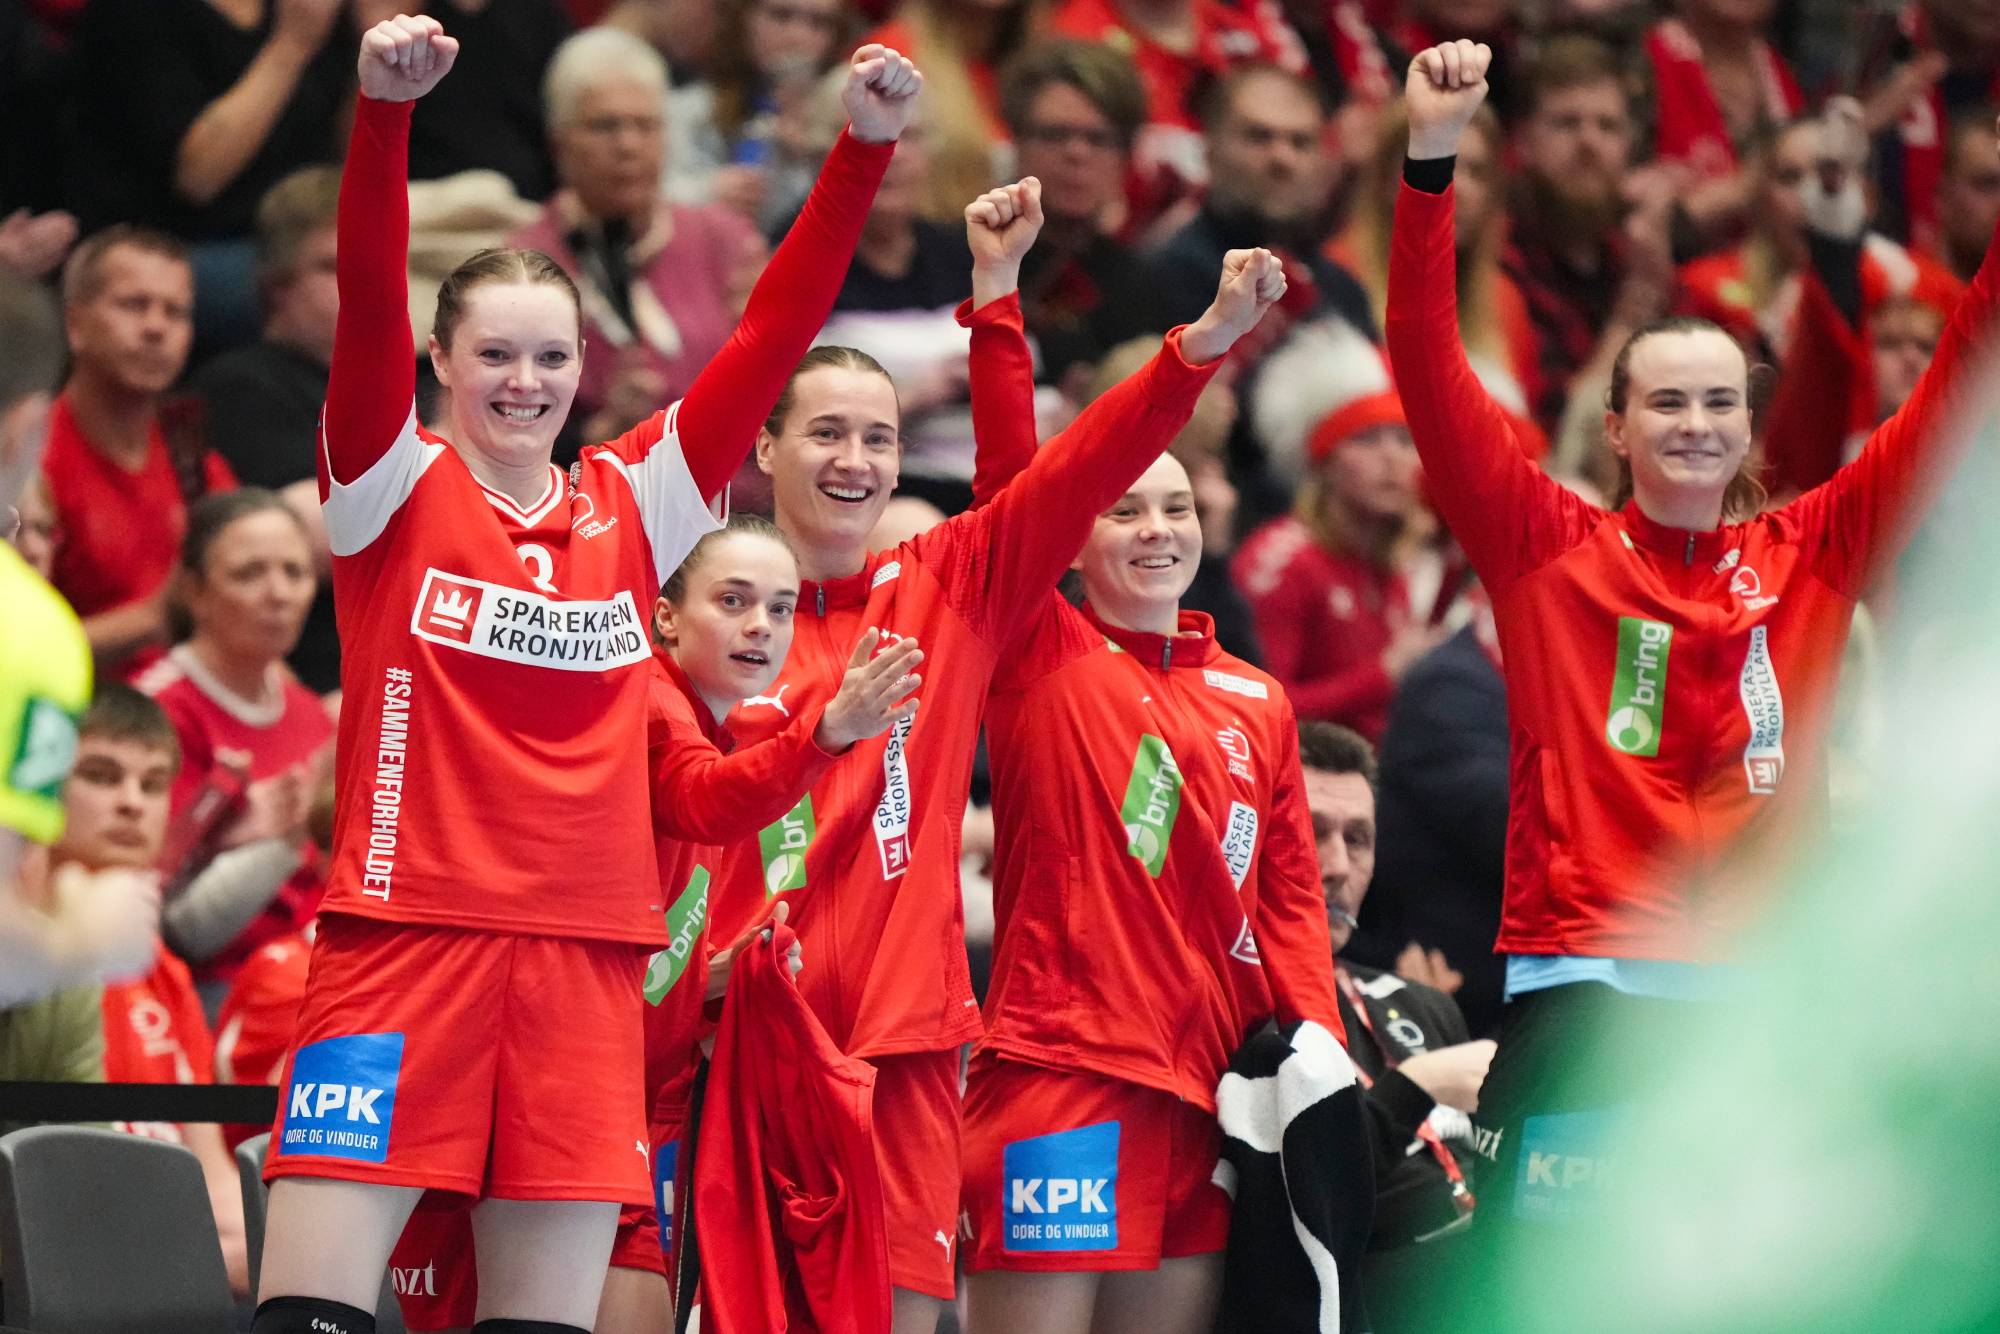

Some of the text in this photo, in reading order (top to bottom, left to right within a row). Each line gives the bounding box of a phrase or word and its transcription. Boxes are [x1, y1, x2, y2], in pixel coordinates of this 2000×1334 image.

[494, 597, 633, 634] SPAREKAEN
[488, 624, 641, 662] KRONJYLAND
[1629, 621, 1671, 706] bring
[361, 666, 413, 902] #SAMMENFORHOLDET
[669, 879, 709, 960] brin
[290, 1083, 384, 1125] KPK
[308, 1129, 323, 1144] OG
[326, 1130, 378, 1150] VINDUER
[1012, 1178, 1108, 1214] KPK
[1012, 1222, 1109, 1240] DØRE OG VINDUER
[391, 1258, 438, 1296] ozt
